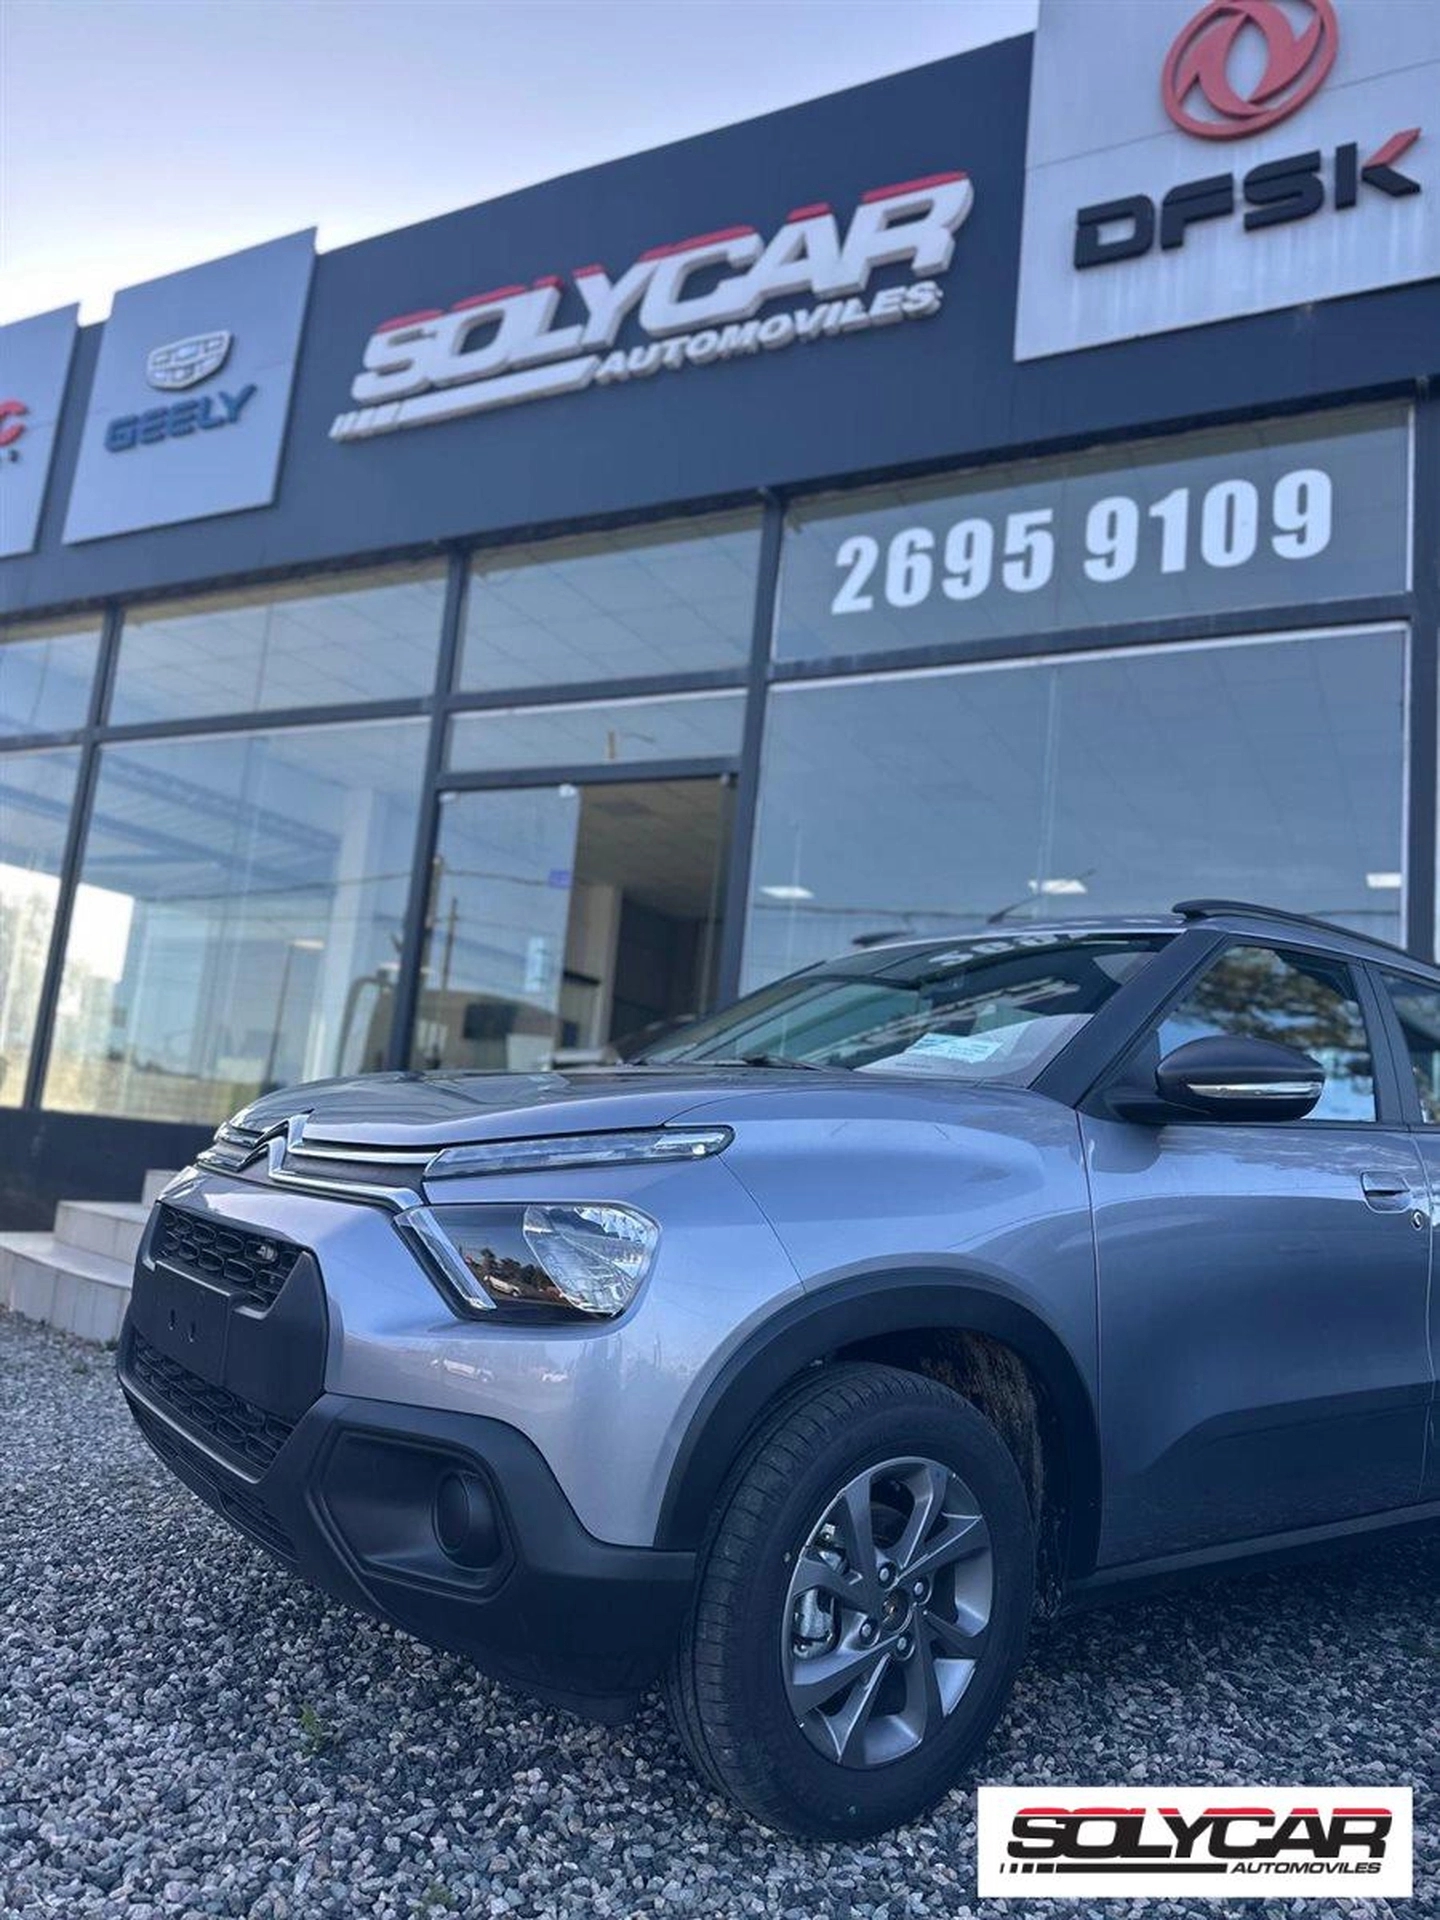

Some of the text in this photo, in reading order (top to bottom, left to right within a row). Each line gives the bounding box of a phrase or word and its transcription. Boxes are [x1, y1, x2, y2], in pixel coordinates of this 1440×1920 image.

[1074, 127, 1422, 271] DFSK
[351, 170, 974, 403] SOLYCAR
[597, 279, 944, 385] AUTOMOVILES
[104, 383, 258, 453] GEELY
[831, 468, 1333, 615] 2695 9109
